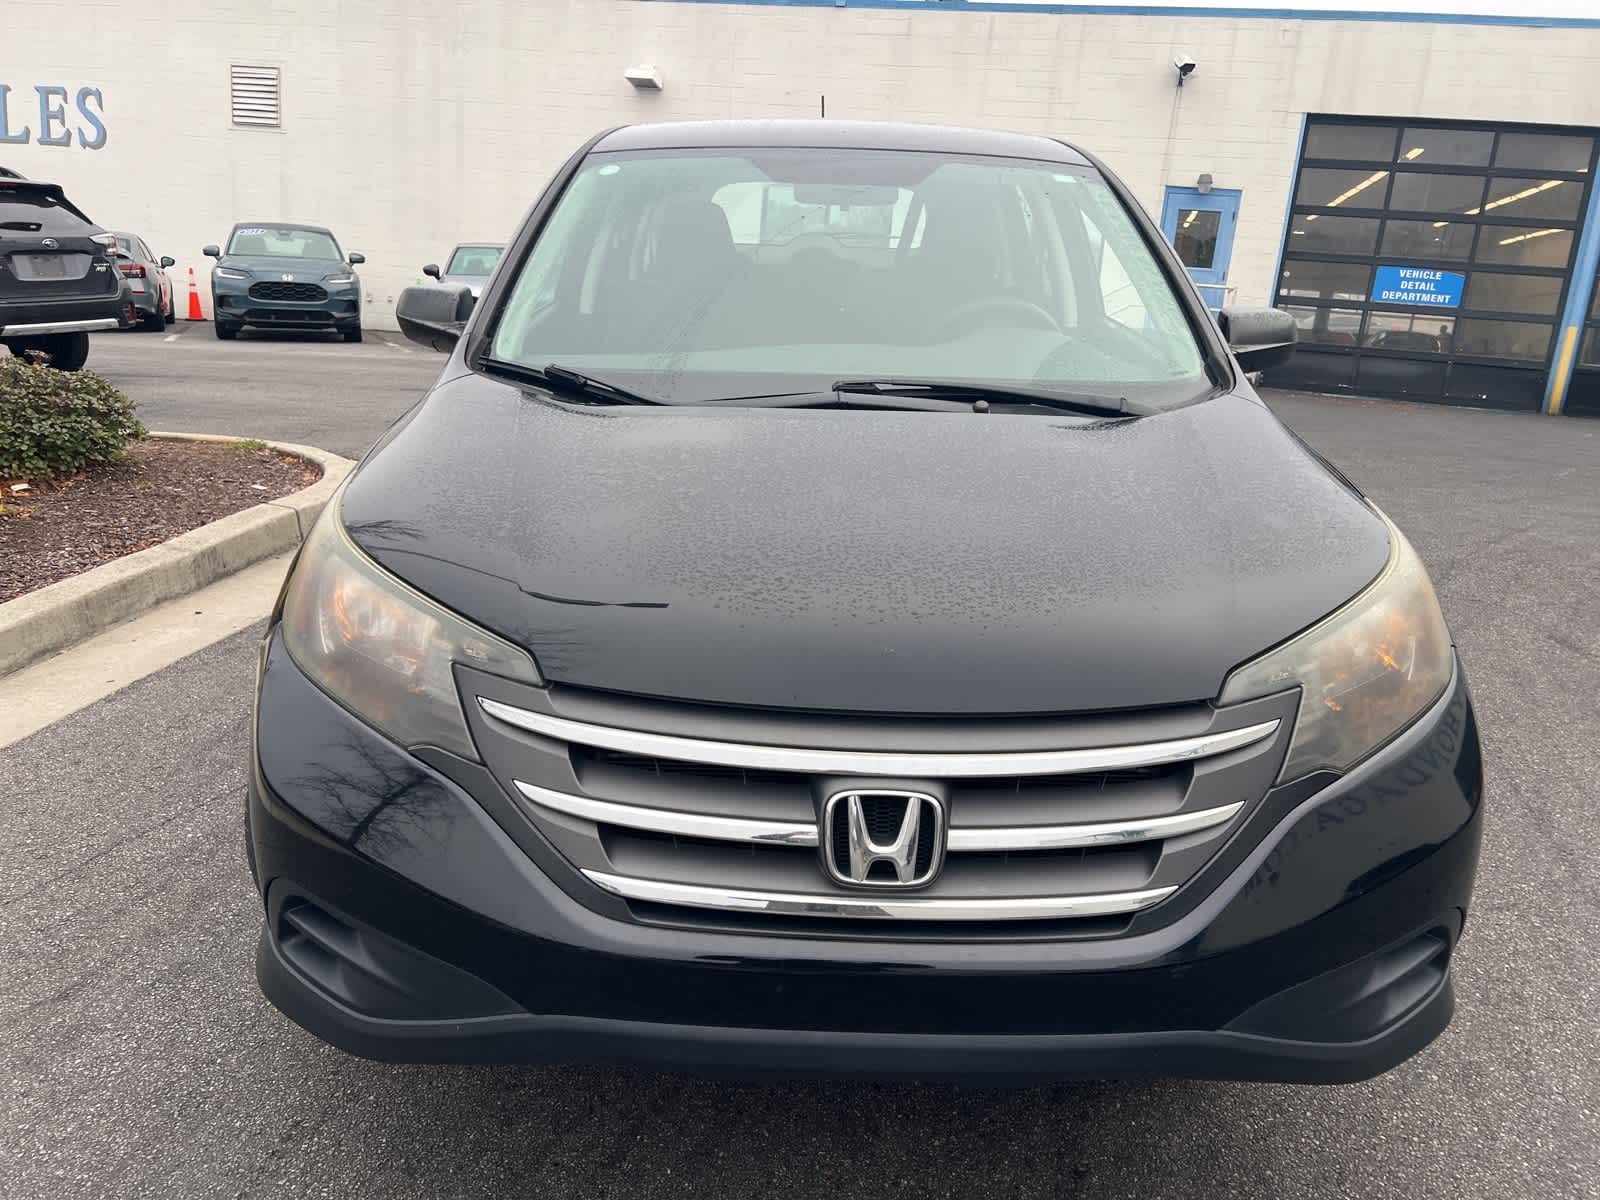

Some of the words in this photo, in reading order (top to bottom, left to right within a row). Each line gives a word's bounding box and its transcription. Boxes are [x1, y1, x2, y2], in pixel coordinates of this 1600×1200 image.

[0, 84, 107, 150] LES
[1399, 269, 1443, 281] VEHICLE
[1400, 281, 1436, 291] DETAIL
[1382, 290, 1452, 304] DEPARTMENT
